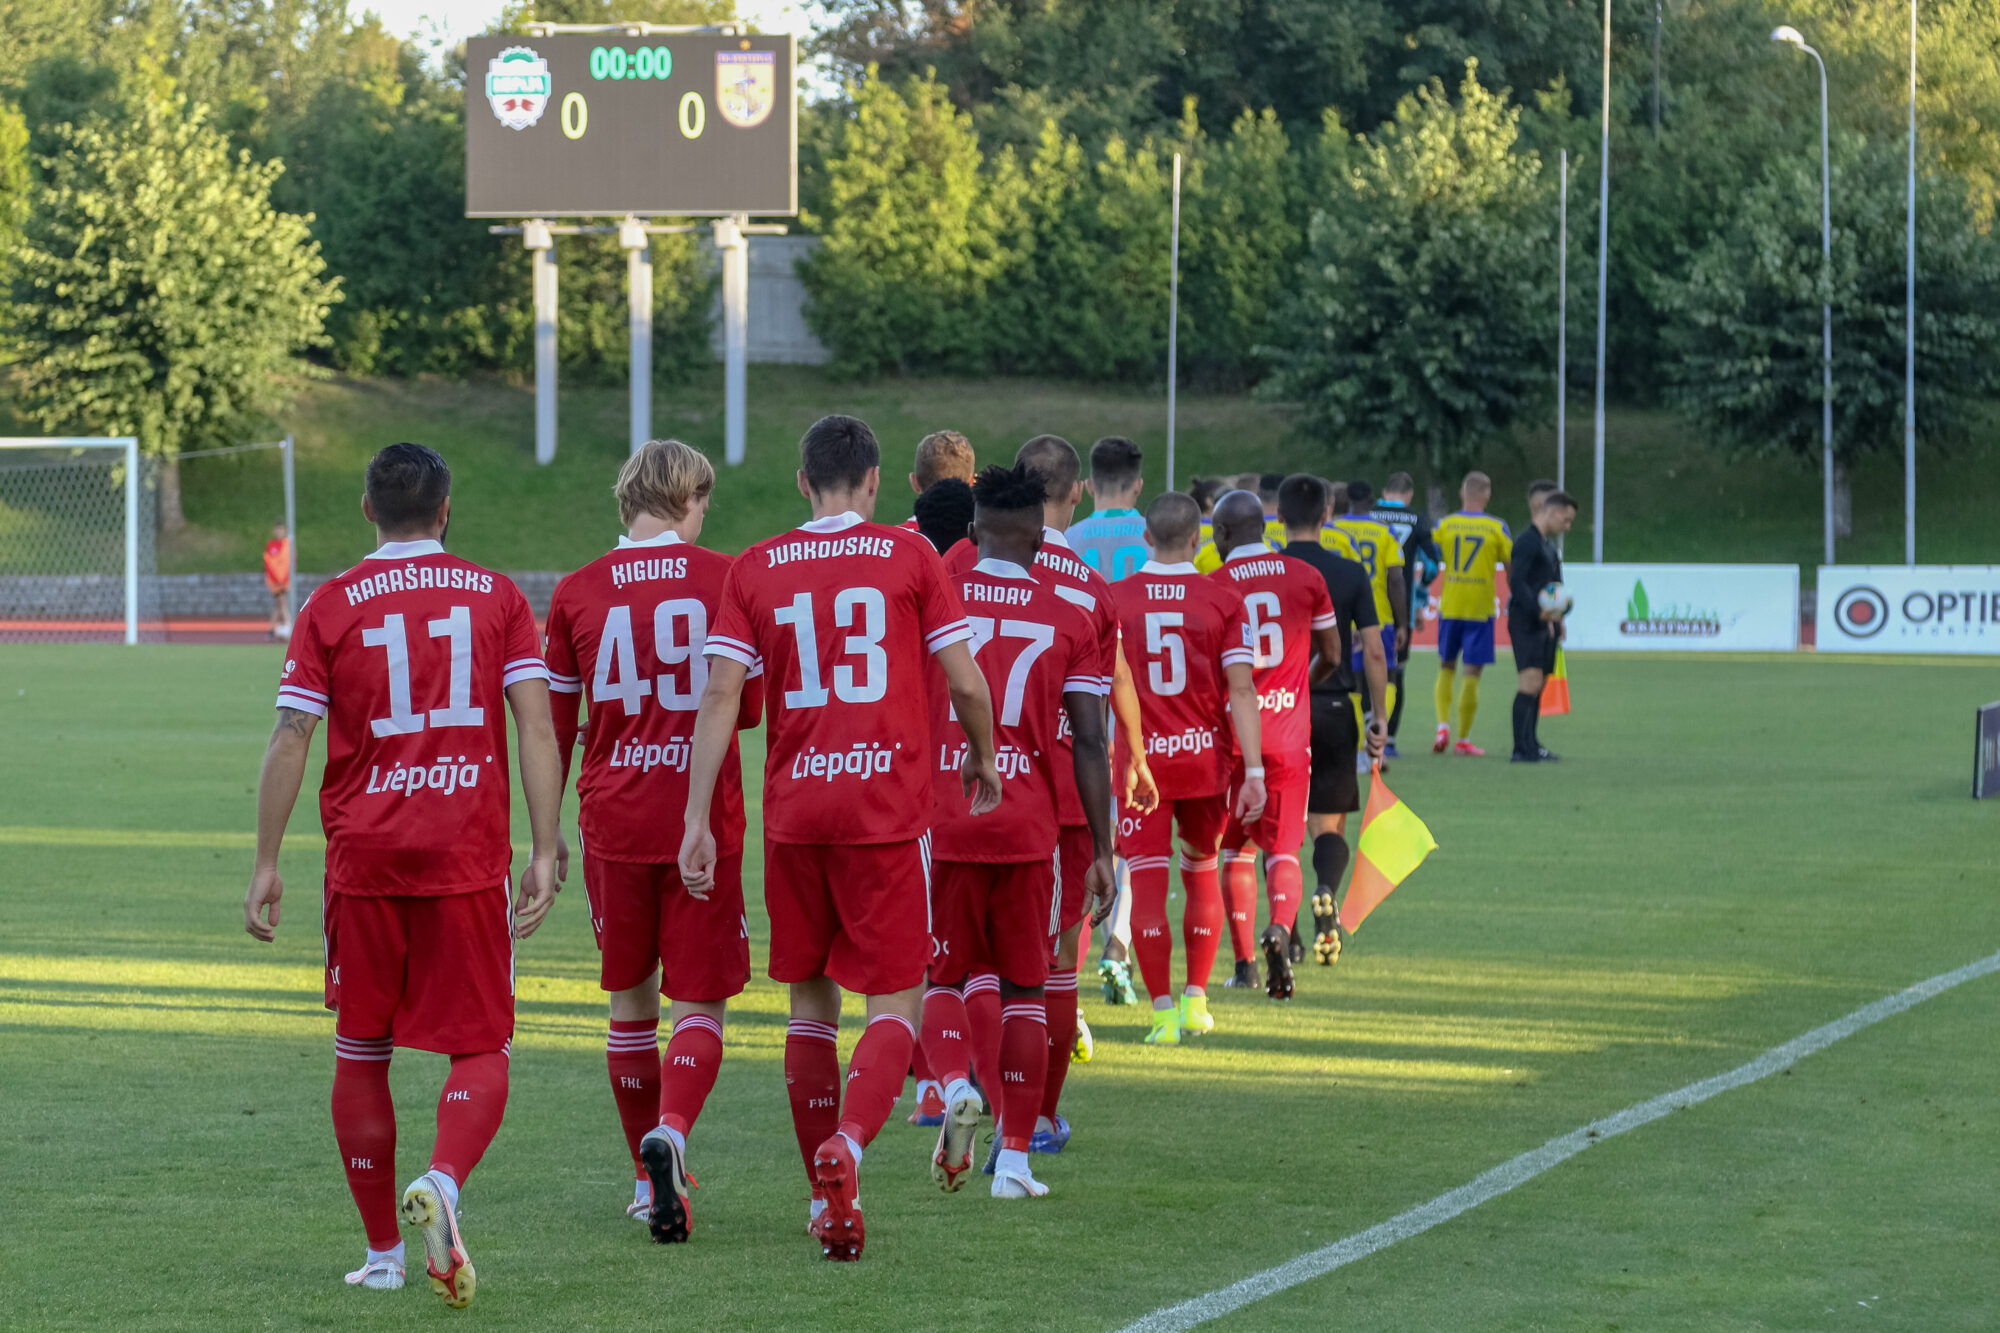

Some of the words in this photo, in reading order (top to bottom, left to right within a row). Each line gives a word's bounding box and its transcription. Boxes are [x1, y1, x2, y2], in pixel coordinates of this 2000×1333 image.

[590, 46, 672, 80] 00:00
[561, 92, 588, 139] 0
[679, 92, 706, 139] 0
[766, 536, 894, 568] JURKOVSKIS
[1229, 560, 1285, 582] YAHAYA
[1454, 535, 1485, 573] 17
[345, 563, 494, 606] KARAŠAUSKS
[963, 582, 1033, 606] FRIDAY
[1145, 584, 1186, 600] TEIJO
[774, 586, 888, 709] 13
[1243, 591, 1284, 669] 6
[362, 606, 484, 738] 11
[592, 598, 709, 716] 49
[1145, 612, 1187, 697] 5
[609, 735, 694, 773] Liepāj
[791, 742, 893, 782] Liepāja
[366, 755, 479, 797] Liepāja
